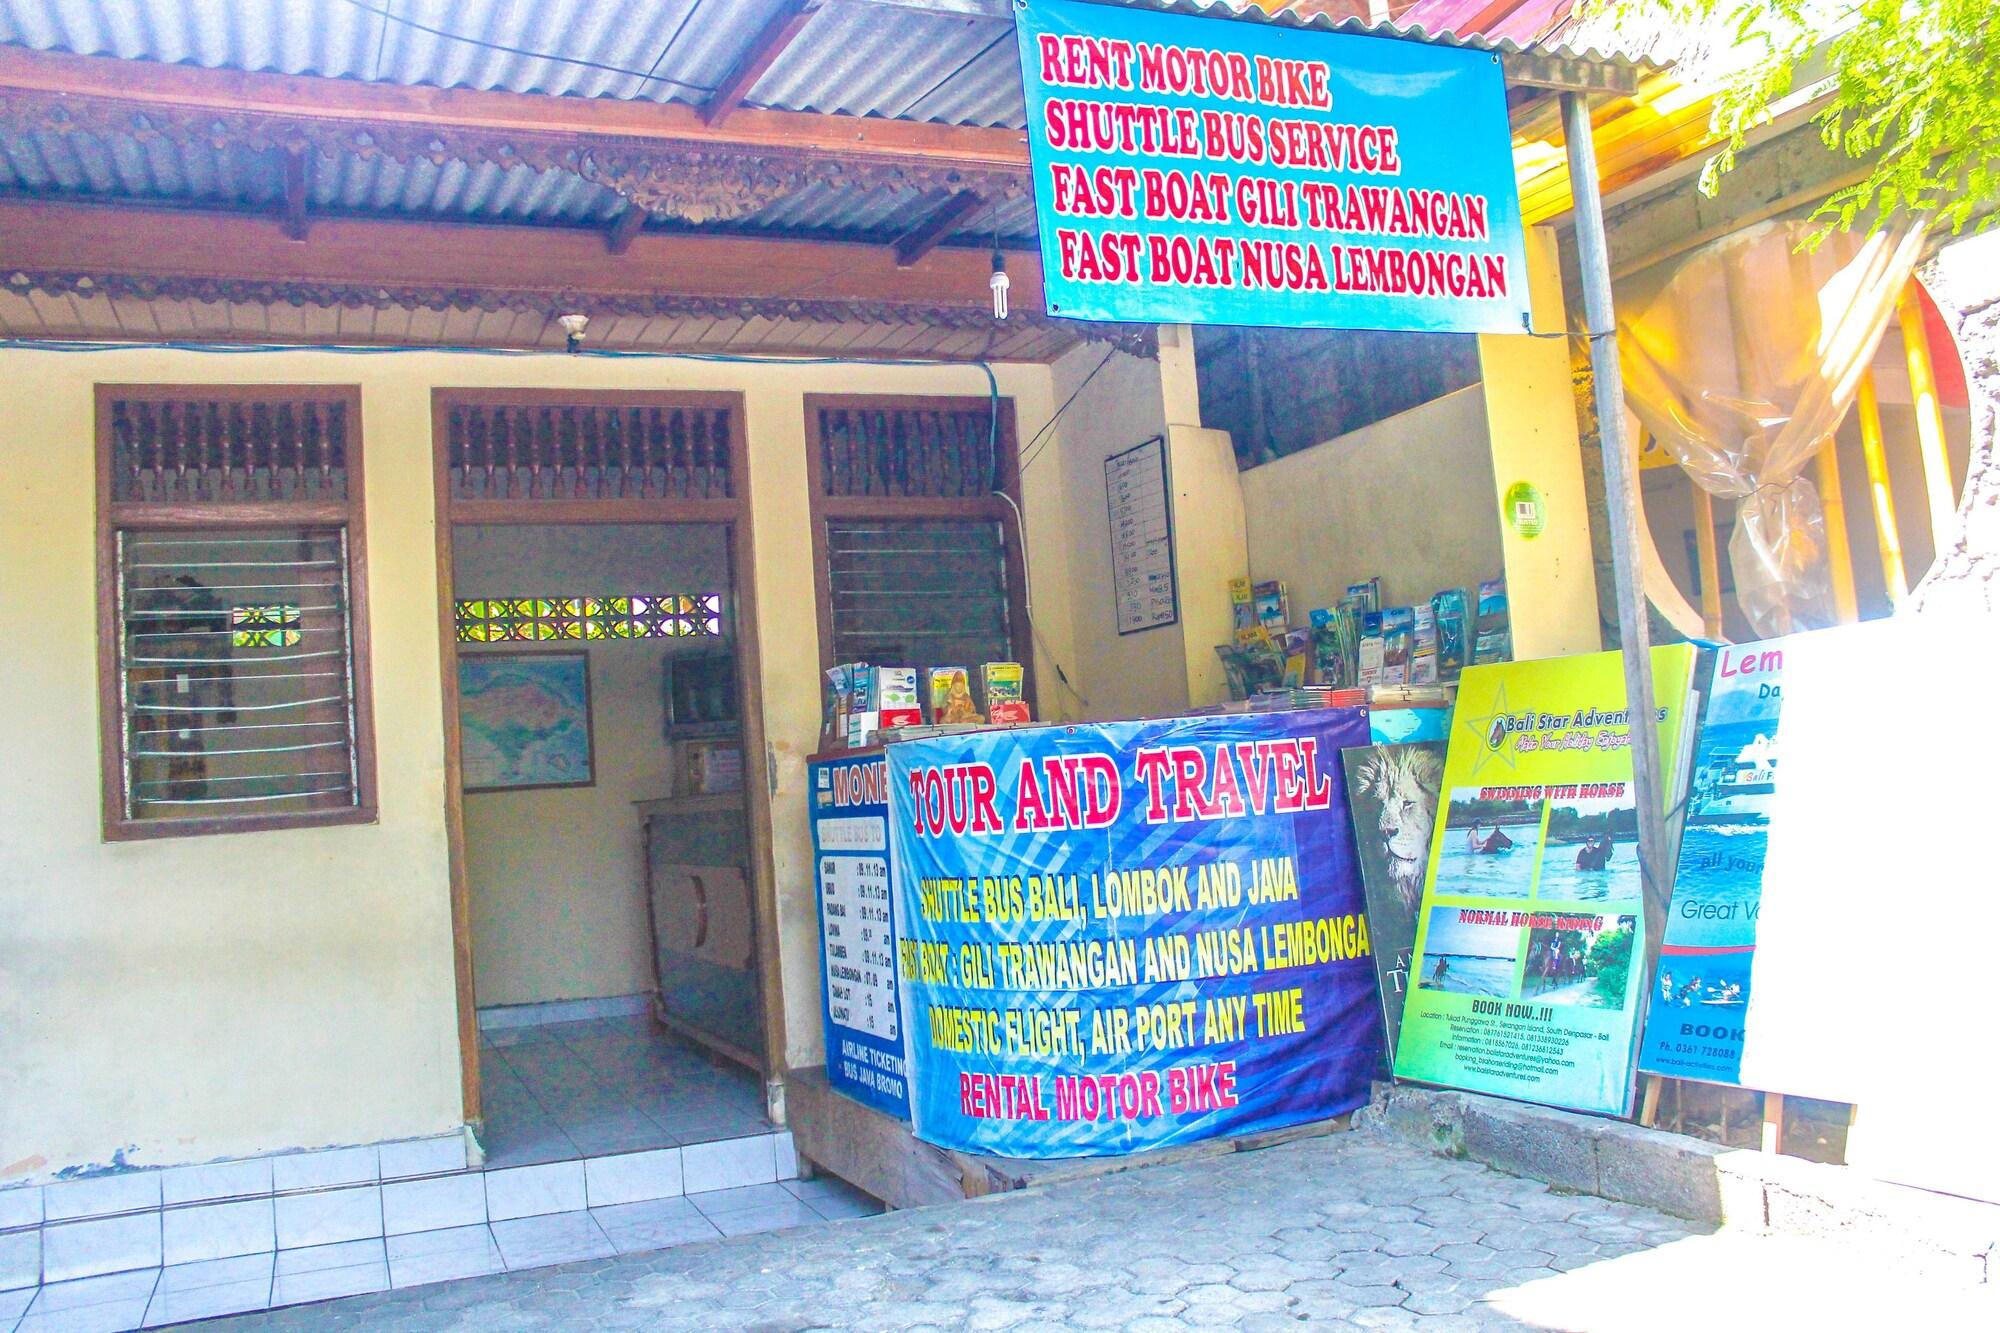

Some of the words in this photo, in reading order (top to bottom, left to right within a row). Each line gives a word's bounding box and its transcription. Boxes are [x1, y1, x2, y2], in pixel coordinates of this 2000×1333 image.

[1037, 33, 1135, 88] RENT
[1140, 43, 1255, 100] MOTOR
[1257, 55, 1331, 109] BIKE
[1046, 103, 1198, 155] SHUTTLE
[1206, 114, 1264, 161] BUS
[1270, 120, 1398, 172] SERVICE
[1051, 164, 1136, 217] FAST
[1144, 170, 1232, 222] BOAT
[1237, 180, 1296, 226] GILI
[1303, 183, 1488, 239] TRAWANGAN
[1059, 230, 1144, 283] FAST
[1150, 234, 1238, 285] BOAT
[1241, 240, 1327, 290] NUSA
[1334, 245, 1507, 298] LEMBONGAN
[1506, 712, 1535, 733] Bali
[1538, 711, 1569, 730] Star
[833, 761, 888, 807] MONE
[910, 762, 1003, 837] TOUR
[1015, 753, 1121, 831] AND
[1135, 737, 1332, 824] TRAVEL
[1543, 784, 1577, 800] WITH
[1579, 782, 1625, 798] HORSE
[1701, 852, 1722, 869] all
[921, 876, 980, 923] SHUTTLE
[984, 874, 1023, 919] BUS
[1030, 865, 1088, 928] BALI,
[1094, 862, 1192, 917] LOMBOK
[1196, 860, 1242, 905] AND
[1247, 857, 1298, 902] JAVA
[1459, 909, 1508, 926] NORMAL
[1511, 912, 1553, 929] HORSE
[1556, 915, 1603, 931] RIDING
[1681, 899, 1739, 921] Great
[900, 937, 919, 981] FAST
[921, 939, 948, 984] BOAT
[962, 940, 995, 989] GILI
[998, 938, 1139, 988] TRAWANGAN
[1144, 936, 1192, 980] AND
[1198, 928, 1258, 977] NUSA
[1263, 914, 1370, 969] LEMBONGA
[1472, 1000, 1501, 1016] BOOK
[928, 1003, 1001, 1056] DOMESTIC
[1005, 1005, 1086, 1065] FLIGHT,
[1092, 1005, 1133, 1055] AIR
[1138, 1000, 1196, 1050] PORT
[1204, 997, 1250, 1045] ANY
[1256, 988, 1305, 1038] TIME
[1421, 1010, 1442, 1021] Location
[1547, 1026, 1562, 1035] South
[1564, 1029, 1593, 1040] Denpasar
[1598, 1032, 1609, 1041] Bali
[1450, 1024, 1480, 1034] Reservation
[1452, 1034, 1481, 1044] Information
[1680, 1023, 1745, 1042] BOOK
[842, 1040, 868, 1063] AIRLINE
[870, 1049, 907, 1078] TICKETING
[1440, 1041, 1453, 1049] Email
[1660, 1041, 1673, 1052] Ph.
[844, 1061, 857, 1079] BUS
[859, 1069, 876, 1088] JAVA
[877, 1075, 902, 1099] BROMO
[960, 1072, 1050, 1122] RENTAL
[1056, 1068, 1164, 1122] MOTOR
[1170, 1061, 1239, 1115] BIKE
